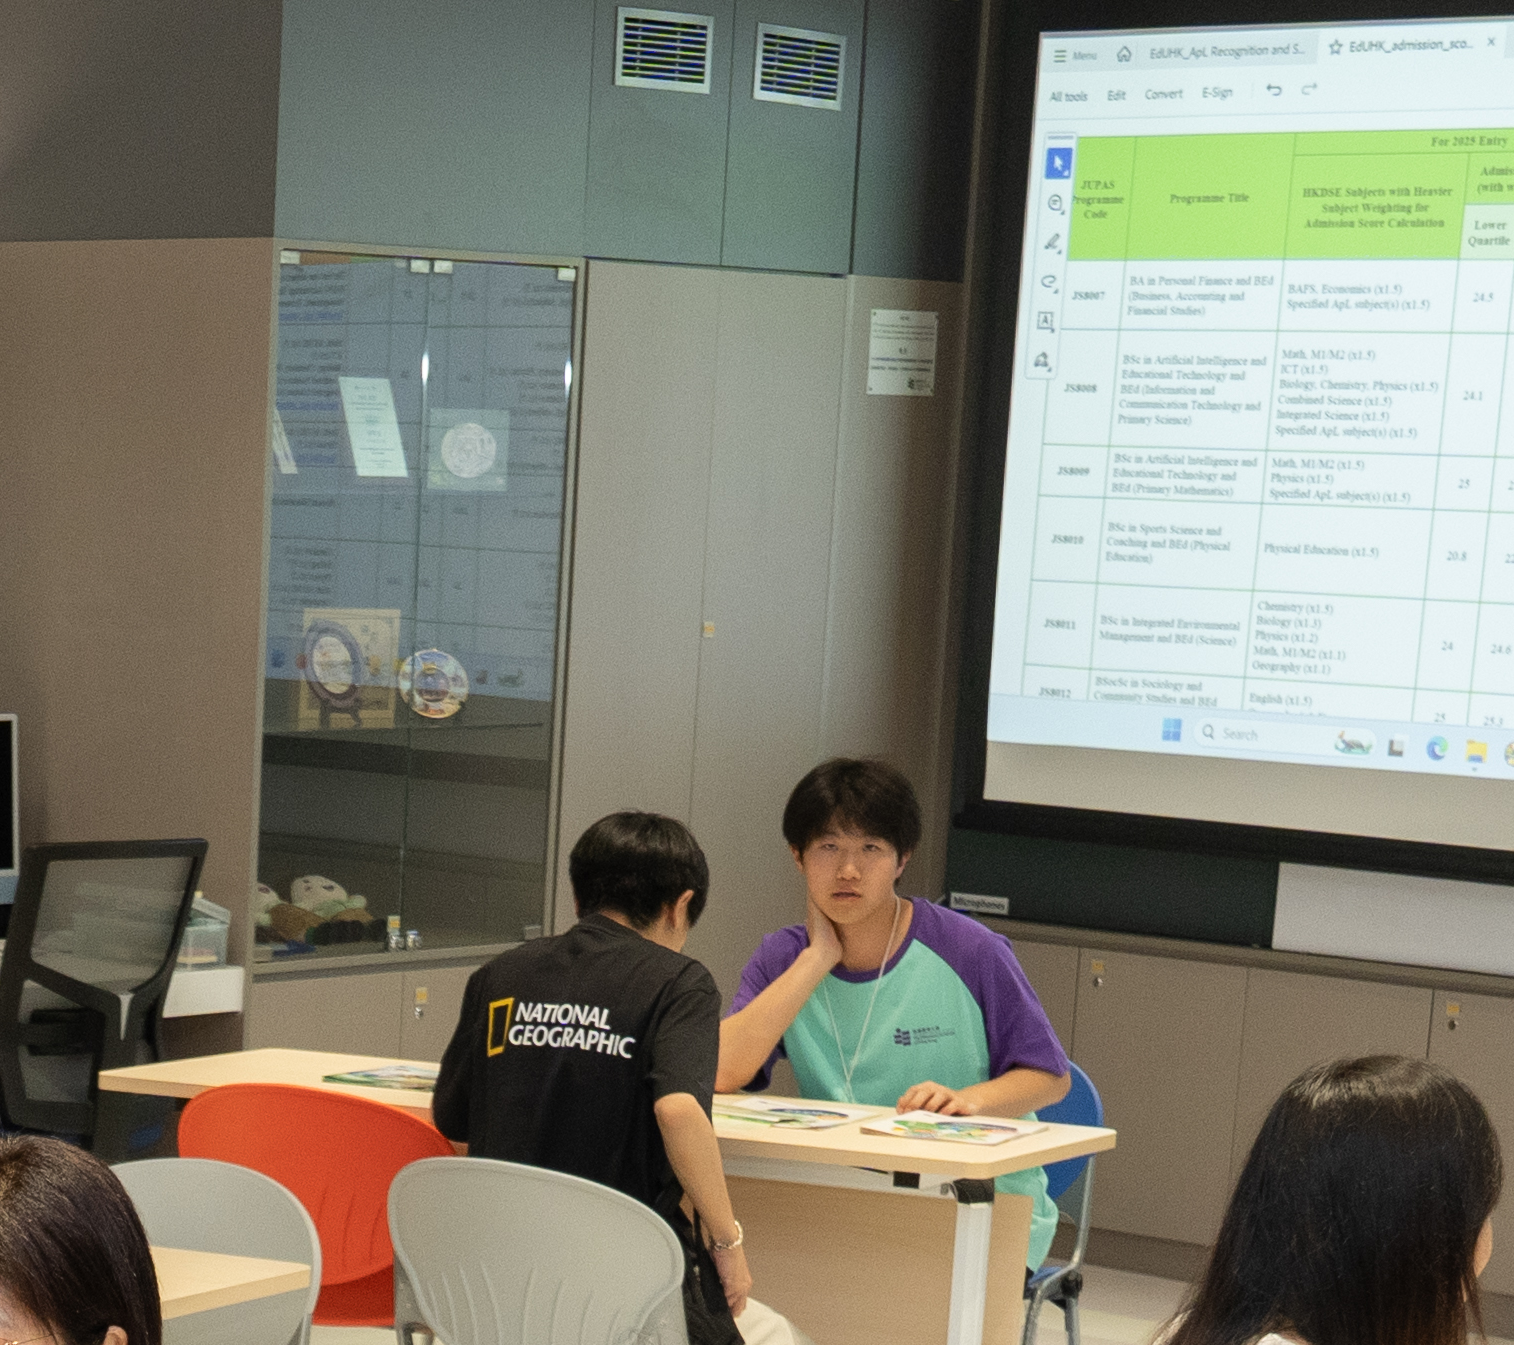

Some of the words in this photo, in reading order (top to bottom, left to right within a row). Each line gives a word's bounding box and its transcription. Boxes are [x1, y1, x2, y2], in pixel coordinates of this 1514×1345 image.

[1049, 90, 1063, 102] All
[1063, 91, 1088, 102] tools
[1106, 89, 1127, 101] Edit
[1144, 87, 1183, 100] Convert
[1201, 85, 1234, 101] E-Sign
[515, 1001, 611, 1030] NATIONAL
[508, 1025, 636, 1059] GEOGRAPHIC
